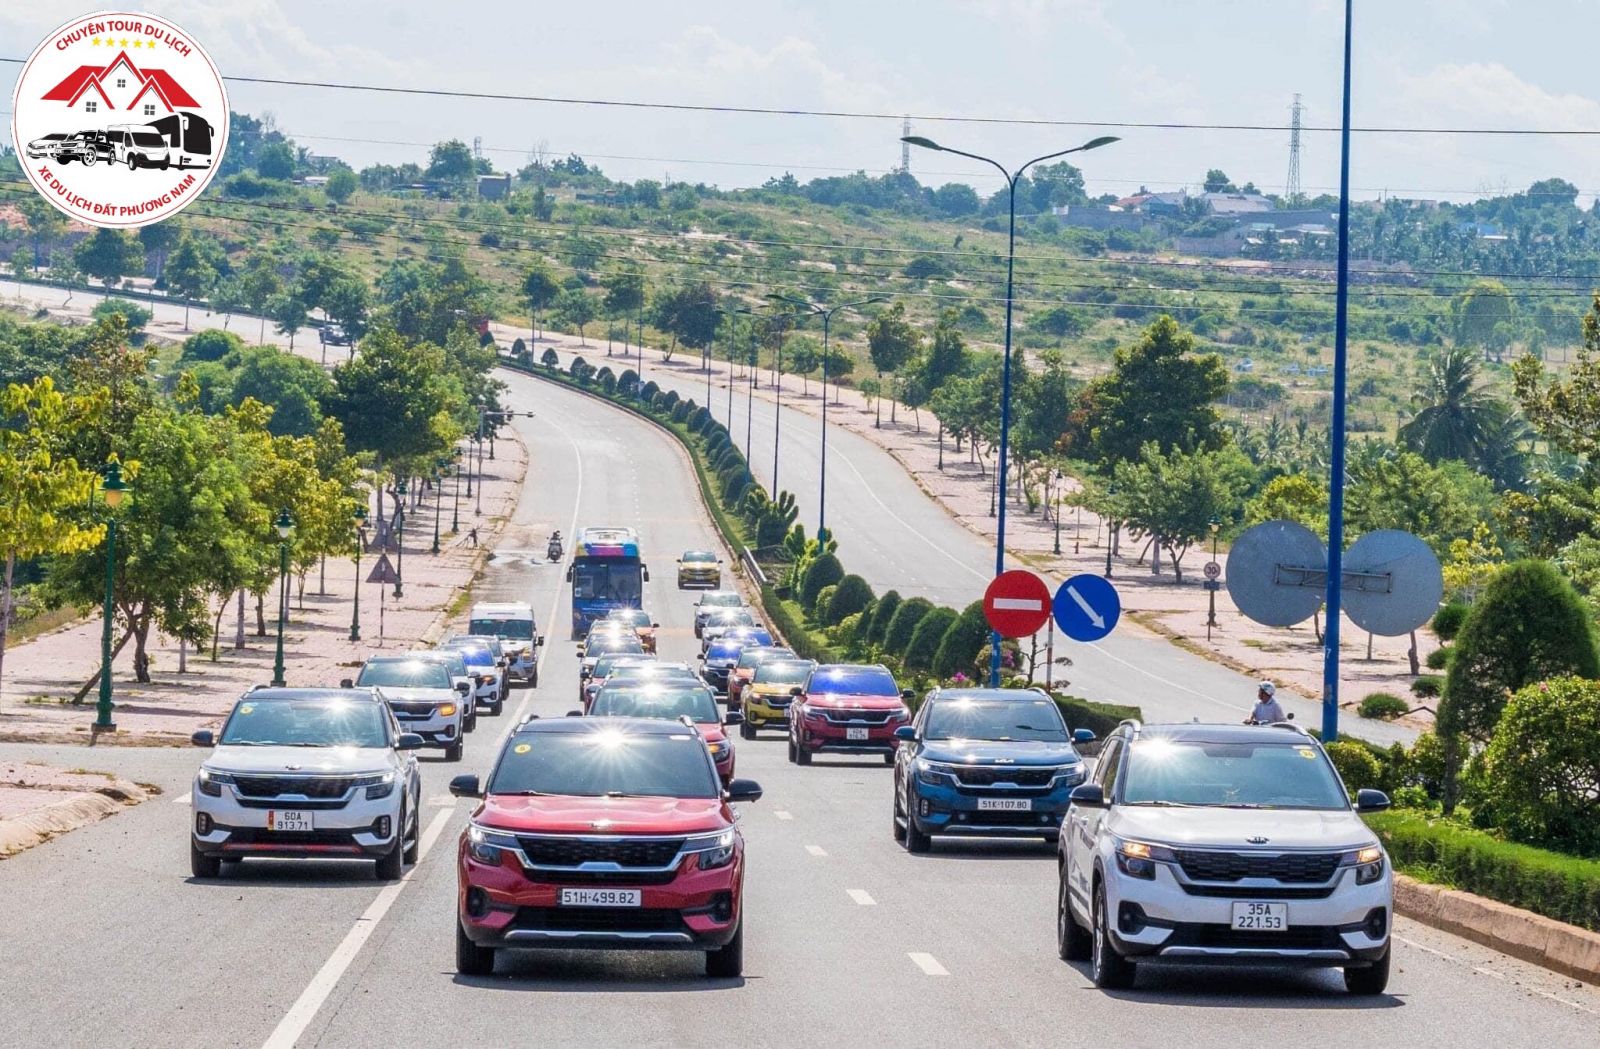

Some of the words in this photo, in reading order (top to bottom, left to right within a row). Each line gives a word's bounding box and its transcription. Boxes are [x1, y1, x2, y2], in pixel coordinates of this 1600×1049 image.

[284, 811, 302, 821] 60A
[277, 821, 308, 830] 913.71
[563, 891, 635, 904] 51H-499.82
[1248, 903, 1271, 916] 35A
[1238, 916, 1281, 929] 221.53
